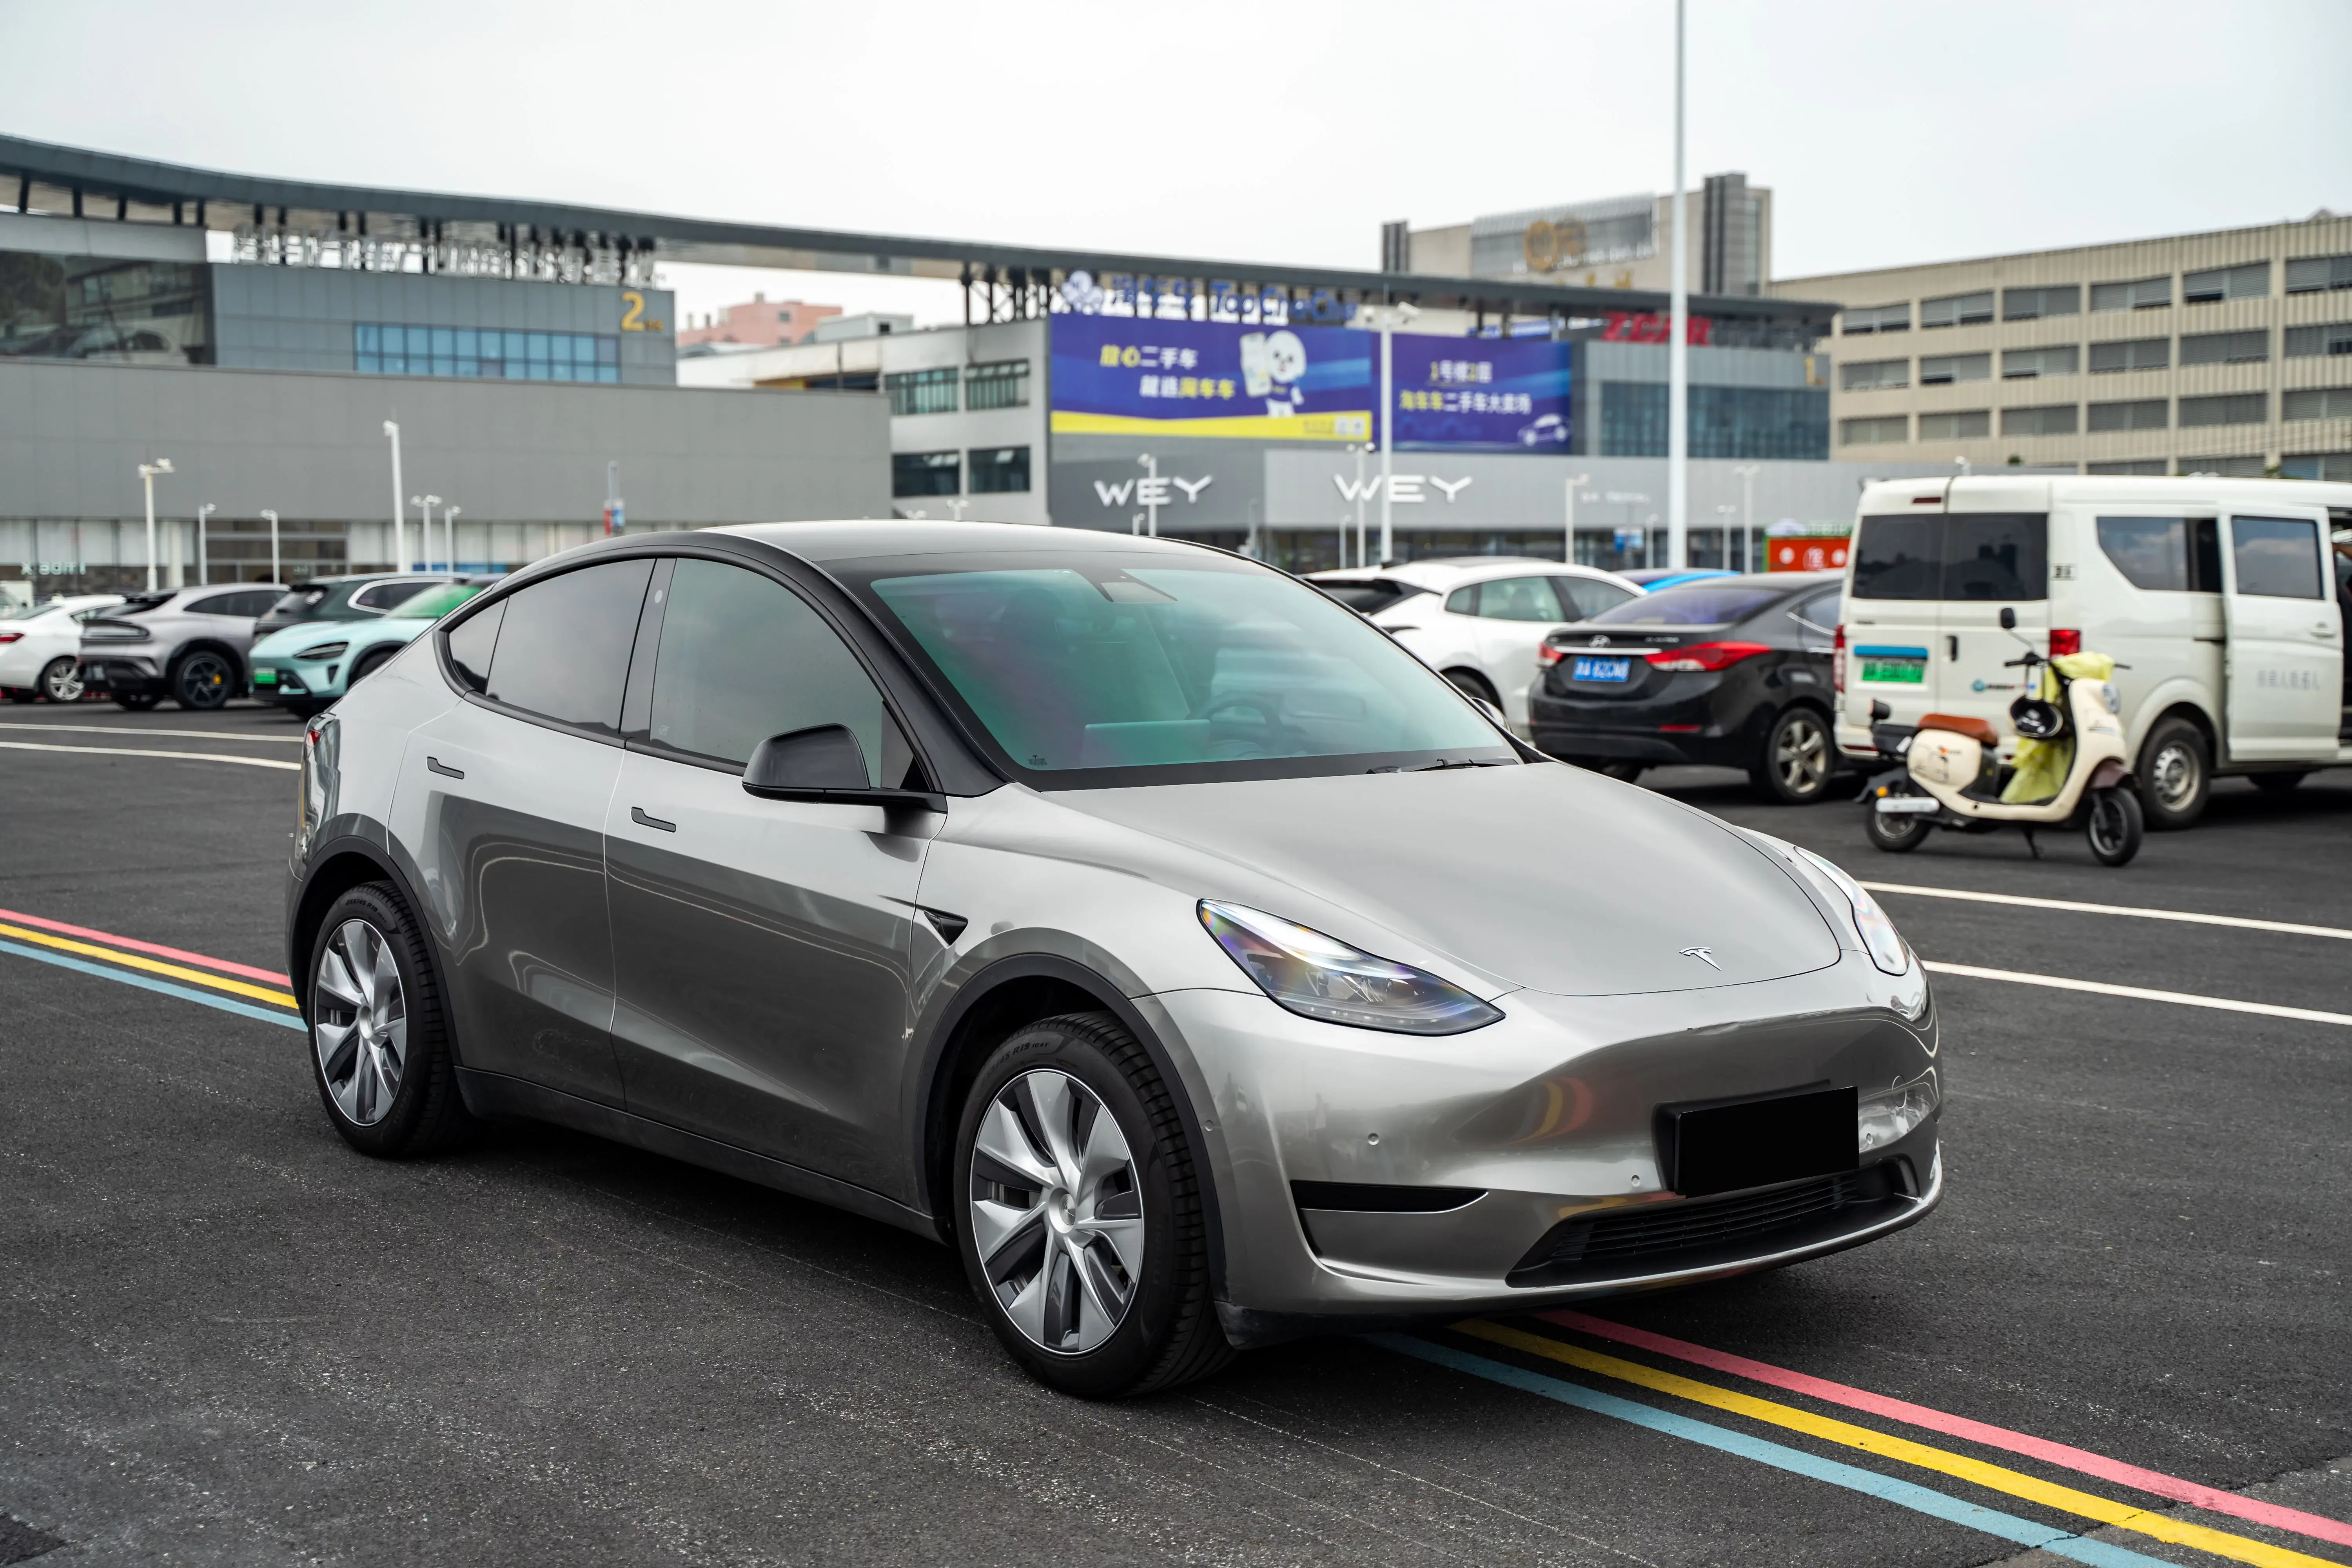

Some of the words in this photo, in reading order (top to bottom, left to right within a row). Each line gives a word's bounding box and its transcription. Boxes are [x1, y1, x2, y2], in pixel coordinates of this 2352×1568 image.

[1094, 475, 1212, 506] WEY
[1334, 474, 1472, 503] WEY
[367, 902, 378, 912] R19
[1013, 1042, 1030, 1055] R19
